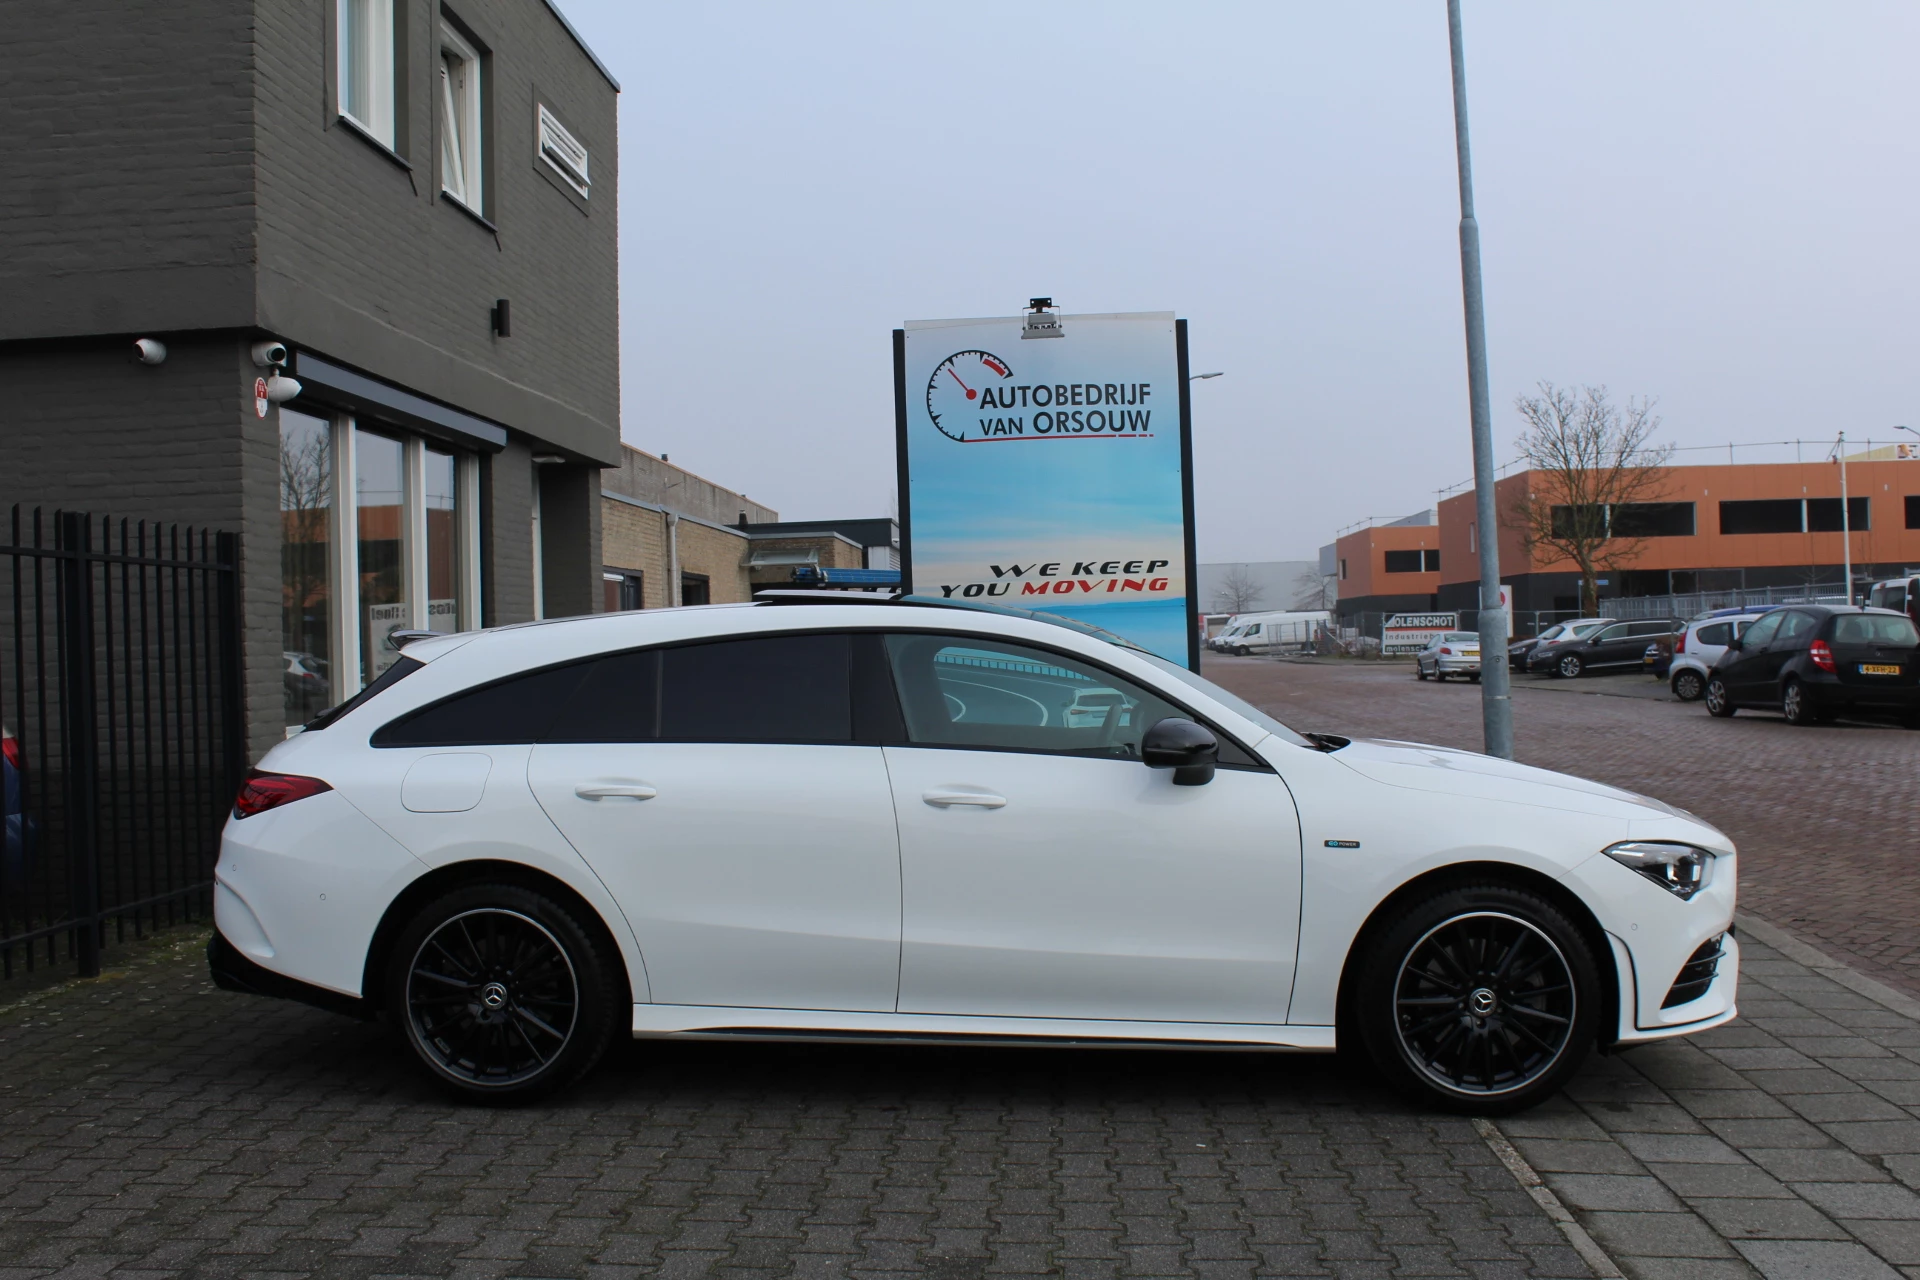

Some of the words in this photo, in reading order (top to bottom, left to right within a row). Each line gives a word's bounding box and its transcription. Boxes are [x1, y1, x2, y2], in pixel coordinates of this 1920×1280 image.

[980, 384, 1151, 409] AUTOBEDRIJF
[979, 417, 1023, 436] VAN
[1032, 410, 1151, 434] ORSOUW
[989, 563, 1061, 578] WE
[1071, 560, 1169, 576] KEEP
[941, 583, 1010, 598] YOU
[1021, 578, 1169, 595] MOVING
[1394, 616, 1453, 627] OLENSCHOT
